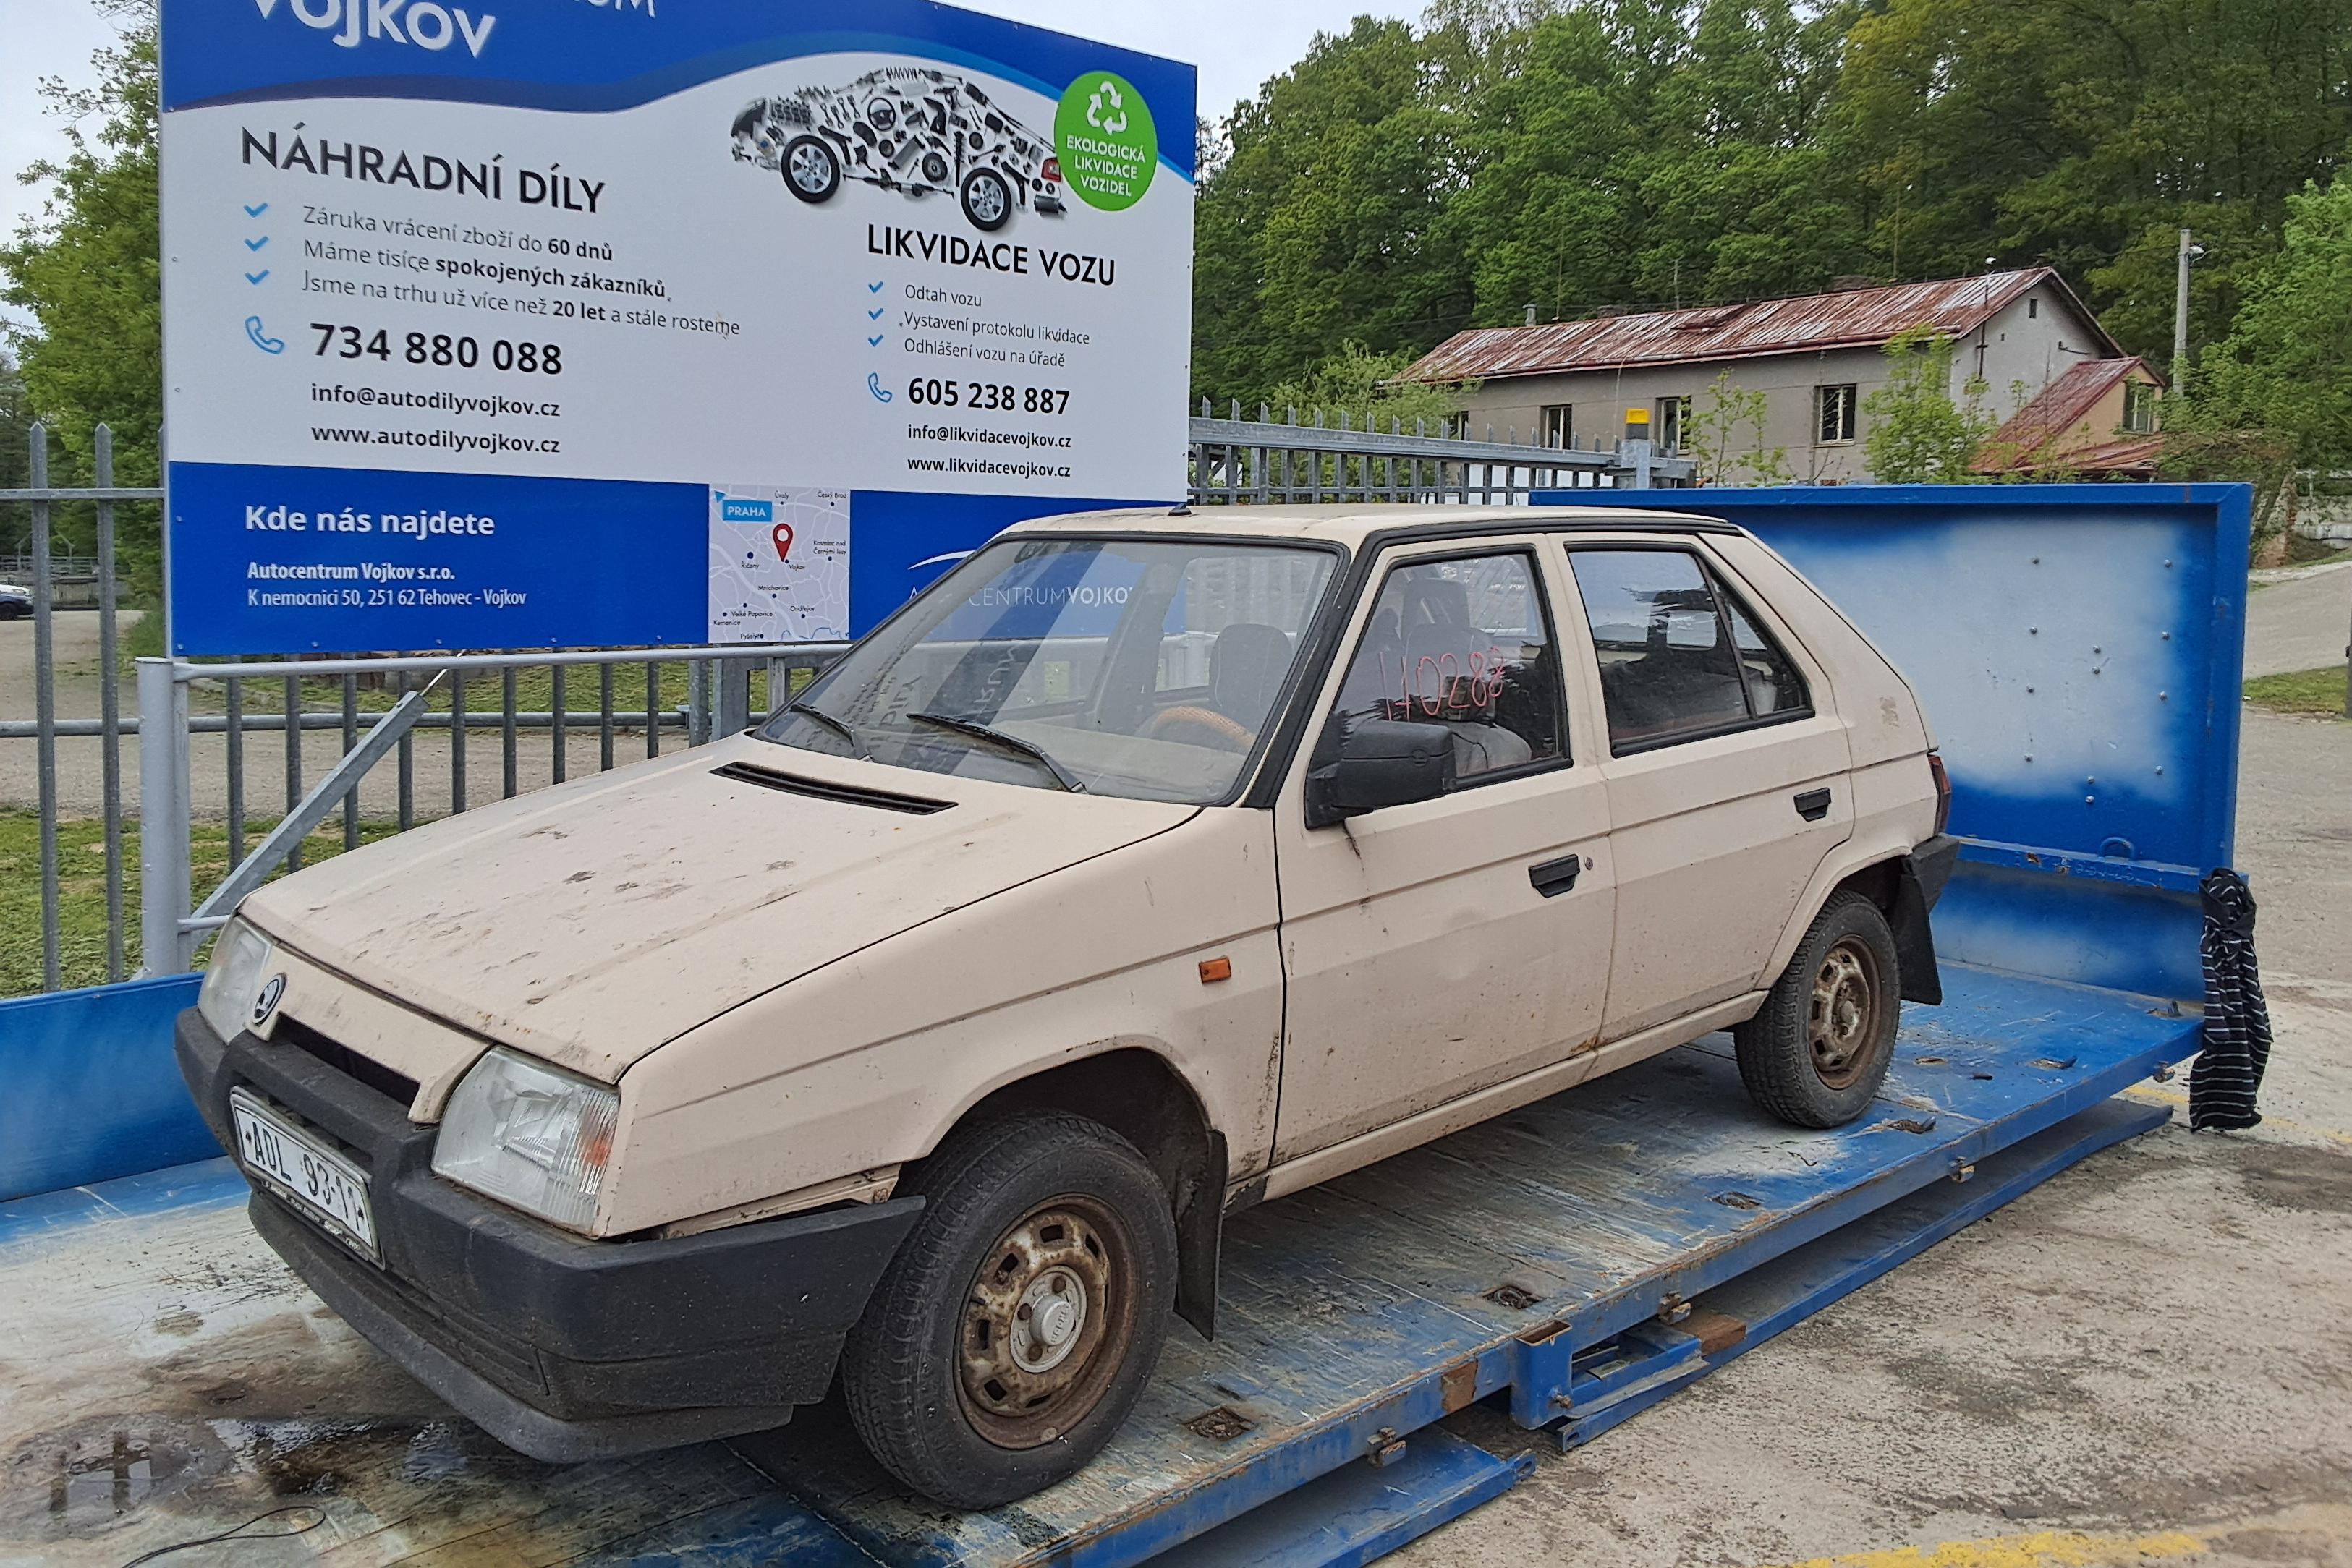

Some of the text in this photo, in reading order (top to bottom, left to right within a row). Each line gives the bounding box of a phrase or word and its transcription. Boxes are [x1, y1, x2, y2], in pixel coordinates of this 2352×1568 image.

[1066, 135, 1146, 163] EKOLOGICKÁ
[242, 122, 606, 214] NÁHRADNÍ DÍLY
[1074, 155, 1138, 180] LIKVIDACE
[1080, 174, 1132, 197] VOZIDEL
[303, 205, 613, 261] Záruka vrácení zboží do 60 dnů
[304, 239, 666, 298] Máme tisíce spokojených zákazníků
[868, 223, 1116, 286] LIKVIDACE VOZU
[301, 270, 741, 336] Jsme na trhu už více než 20 let a stále rosteme
[905, 284, 982, 307] Odtah vozu
[904, 310, 1090, 345] Vystavení protokolu likvidace
[310, 323, 563, 375] 734 880 088
[904, 338, 1066, 367] Odhlášení vozu na úřadě
[311, 383, 561, 417] info@autodilyvojkov.cz
[908, 378, 1070, 414] 605 238 887
[310, 427, 561, 454] www.autodilyvojkov.cz
[908, 424, 1071, 449] info@likvidacevojkov.cz
[907, 457, 1071, 480] www.likvidacevojkov.cz
[245, 505, 496, 540] Kde nás najdete
[727, 506, 766, 517] PRAHA
[247, 562, 456, 584] Autocentrum Vojkov s.r.o.
[247, 589, 259, 606] K
[262, 590, 339, 607] nemocnici
[341, 589, 365, 608] 50,
[368, 589, 394, 606] 251
[396, 589, 416, 606] 62
[417, 589, 472, 606] Tehovec
[483, 589, 527, 609] Vojkov
[252, 1121, 292, 1182] ADL
